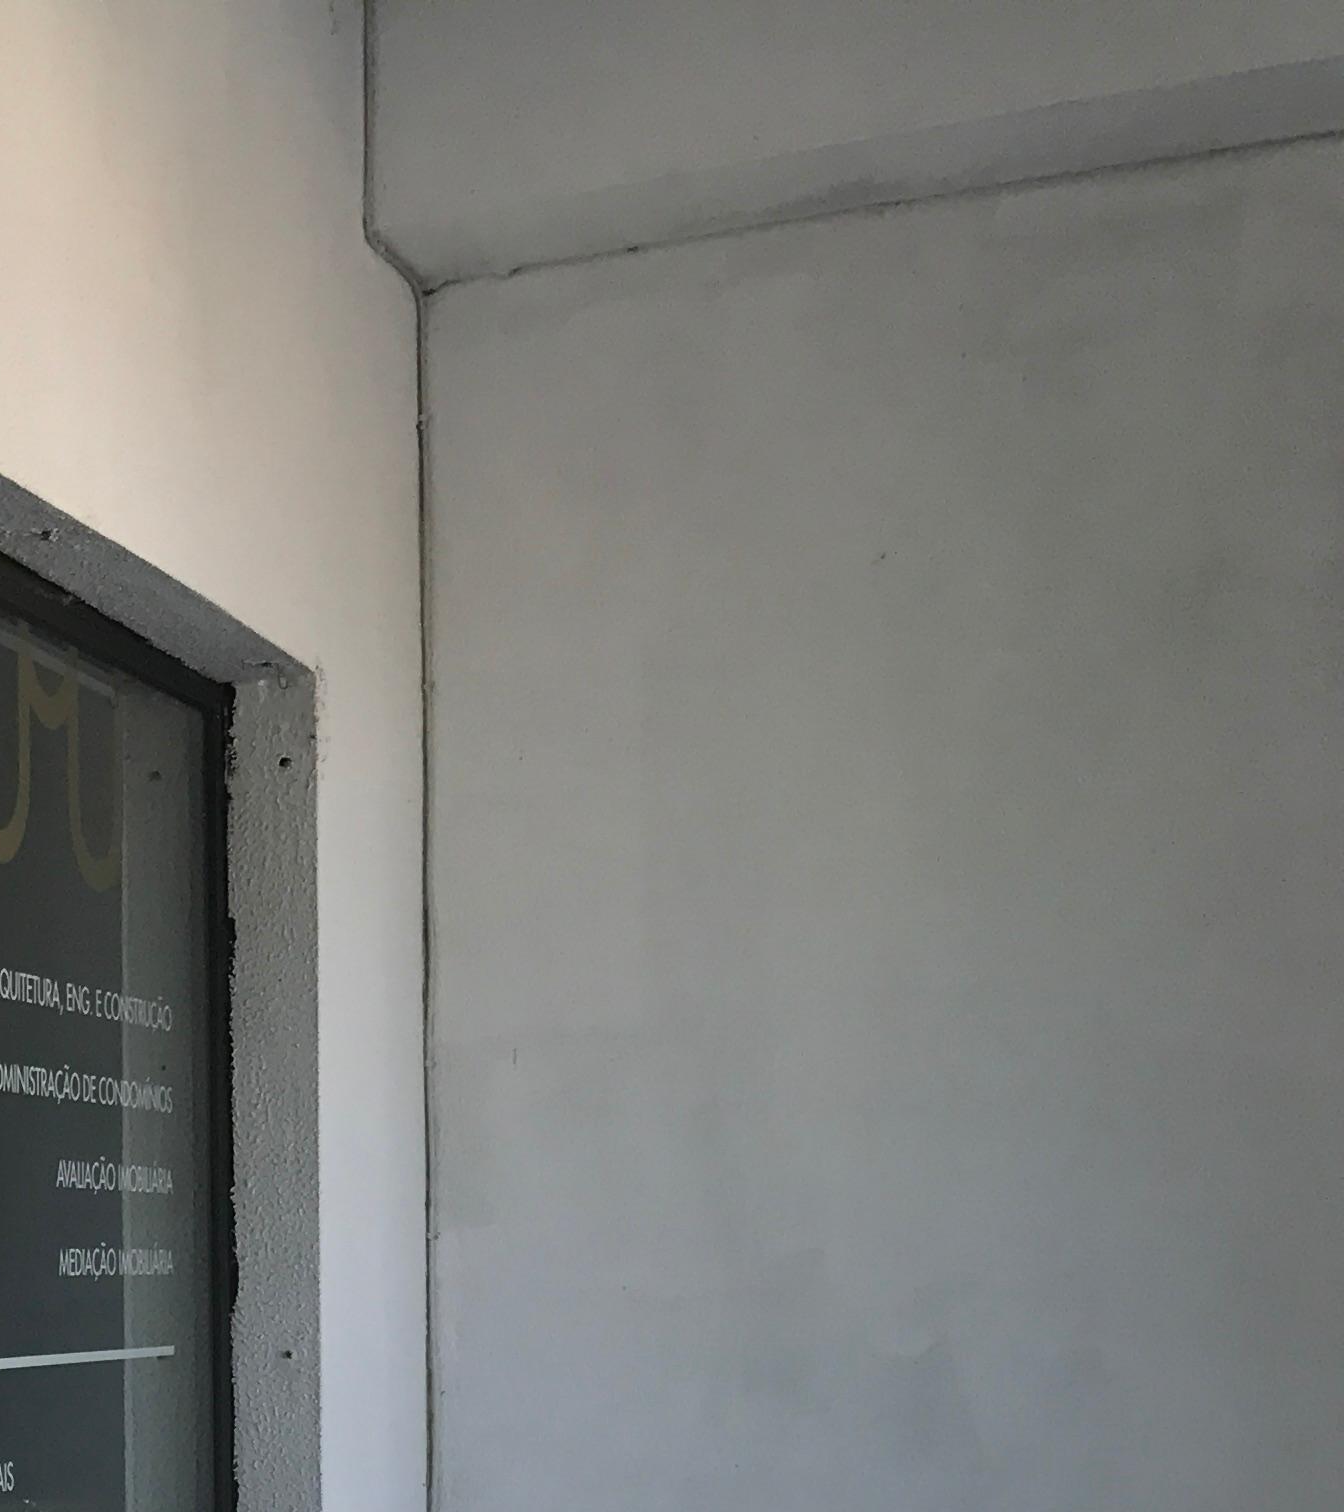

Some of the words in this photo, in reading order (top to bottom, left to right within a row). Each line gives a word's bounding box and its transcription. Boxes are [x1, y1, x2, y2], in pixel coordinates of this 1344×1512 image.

[66, 982, 93, 1015] ENG.
[96, 989, 103, 1018] E
[83, 1074, 97, 1104] DE
[98, 1076, 173, 1113] CONDOMÍNIOS
[56, 1155, 116, 1195] AVALIAÇÃO
[58, 1241, 116, 1282] MEDIAÇÃO
